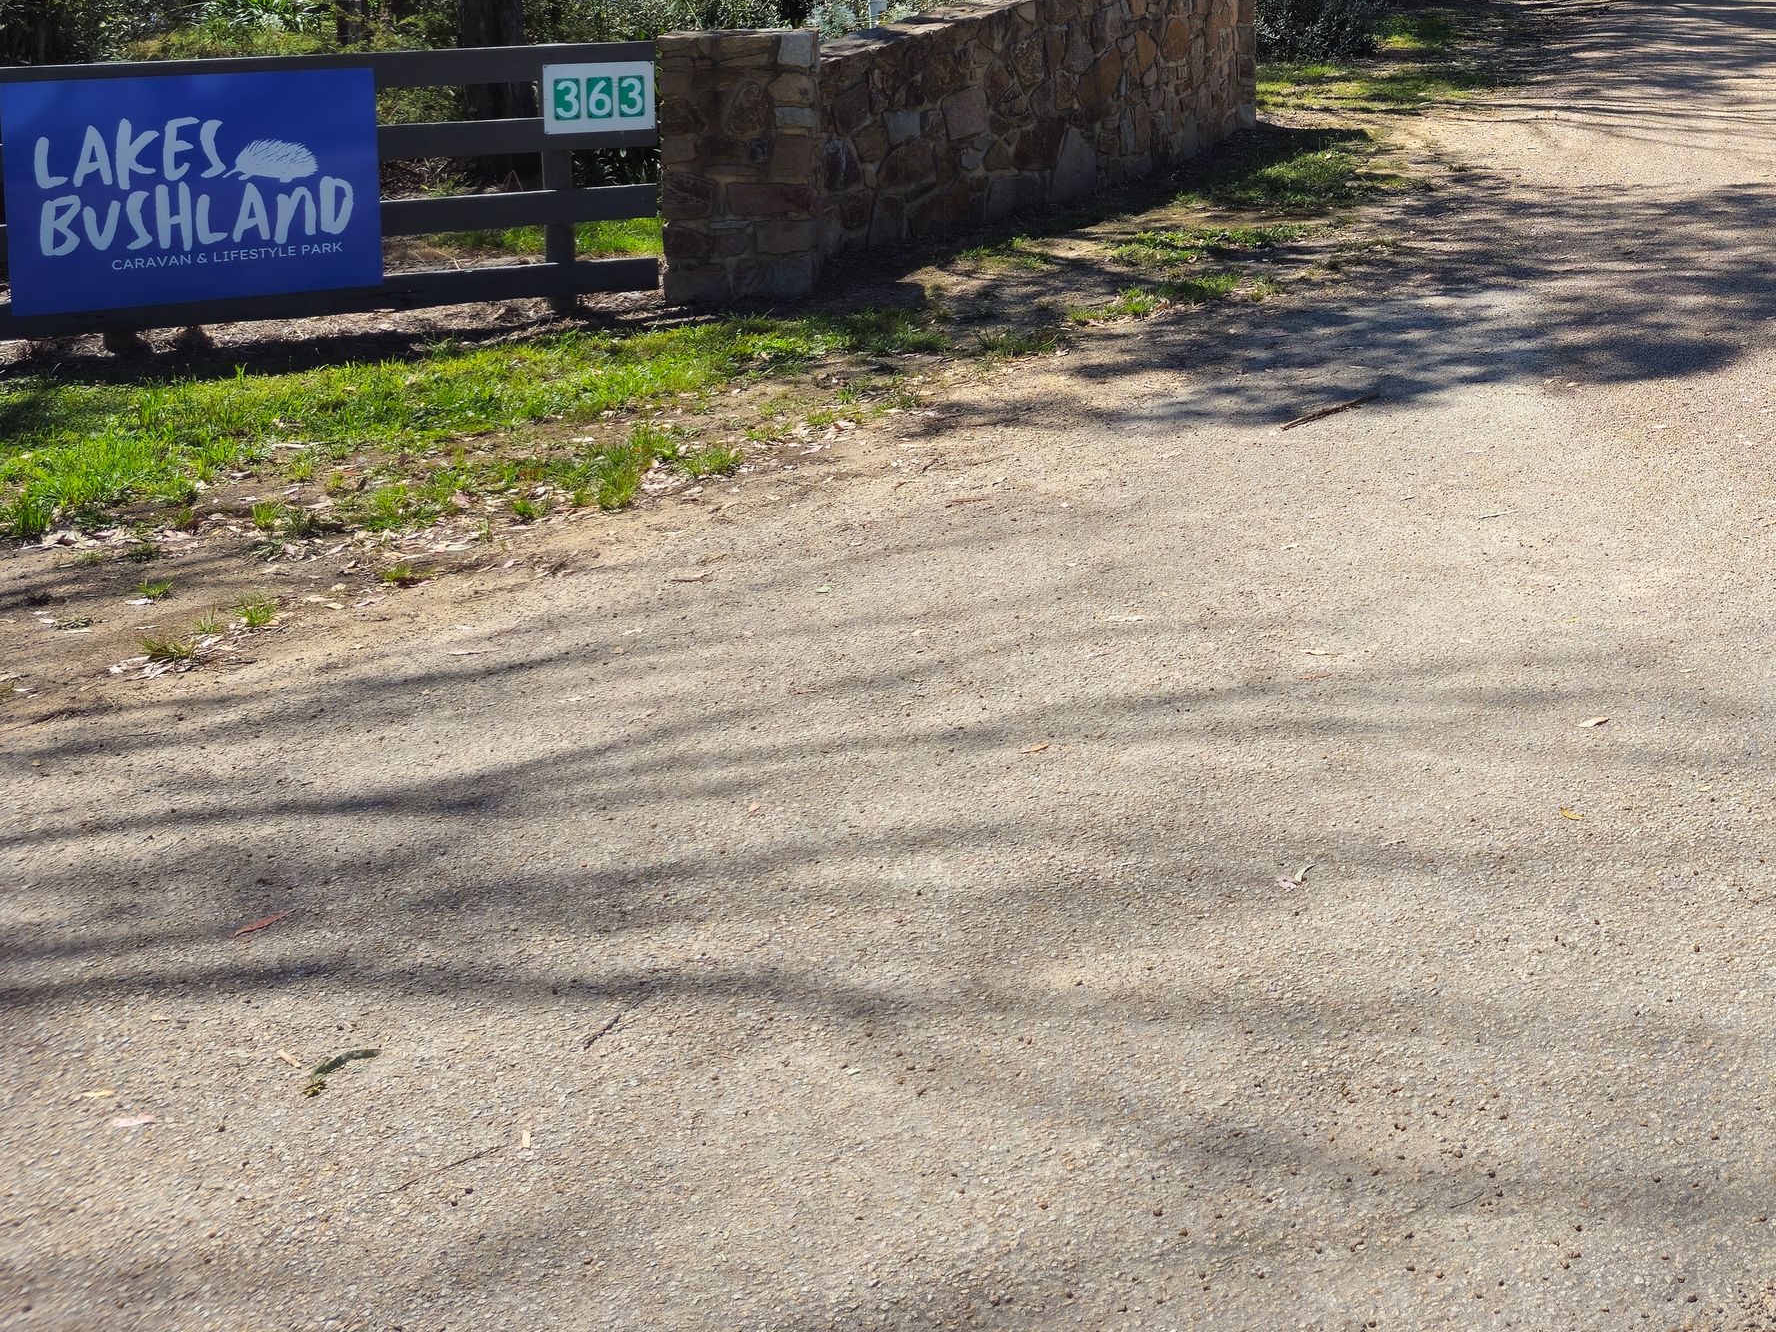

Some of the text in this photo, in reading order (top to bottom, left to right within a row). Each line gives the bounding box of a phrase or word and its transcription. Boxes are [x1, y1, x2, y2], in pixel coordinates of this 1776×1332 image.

[556, 77, 643, 118] 363
[34, 116, 227, 190] LAKES
[39, 176, 354, 257] BUSHLAND
[111, 241, 344, 270] CARAVAN & LIFESTYLE PARK
